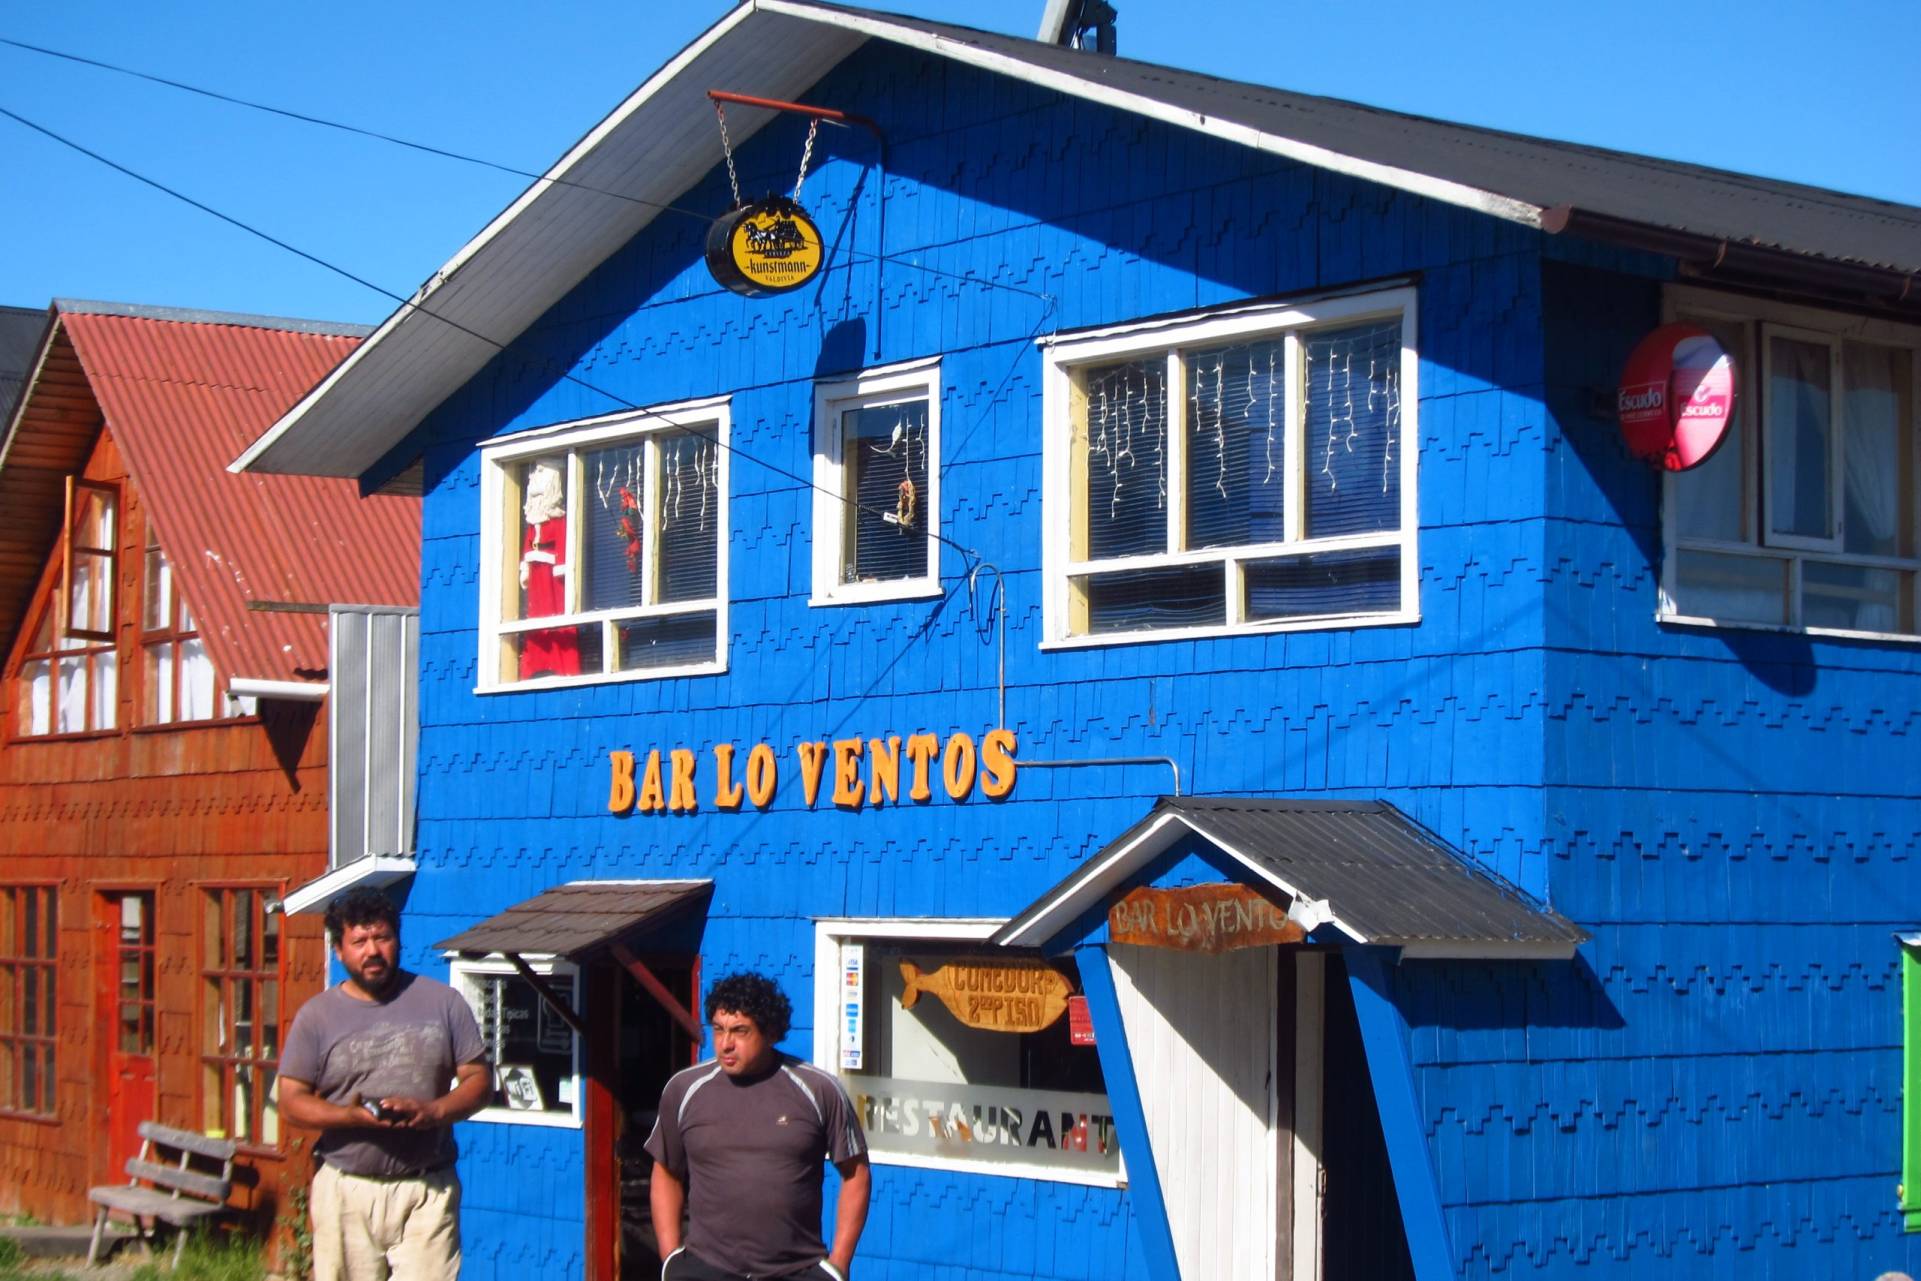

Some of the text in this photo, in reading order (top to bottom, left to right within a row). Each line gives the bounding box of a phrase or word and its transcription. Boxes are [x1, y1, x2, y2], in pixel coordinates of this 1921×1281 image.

[749, 259, 807, 274] kunstmann
[1618, 387, 1662, 411] Escudo
[1681, 402, 1722, 417] Escudo
[608, 728, 1018, 814] BAR LO VENTOS
[1114, 899, 1159, 935] BAR
[1165, 899, 1197, 937] LO
[954, 965, 1044, 993] COMEDOR
[992, 995, 1040, 1026] PISO
[857, 1094, 1115, 1154] RESTAURANT
